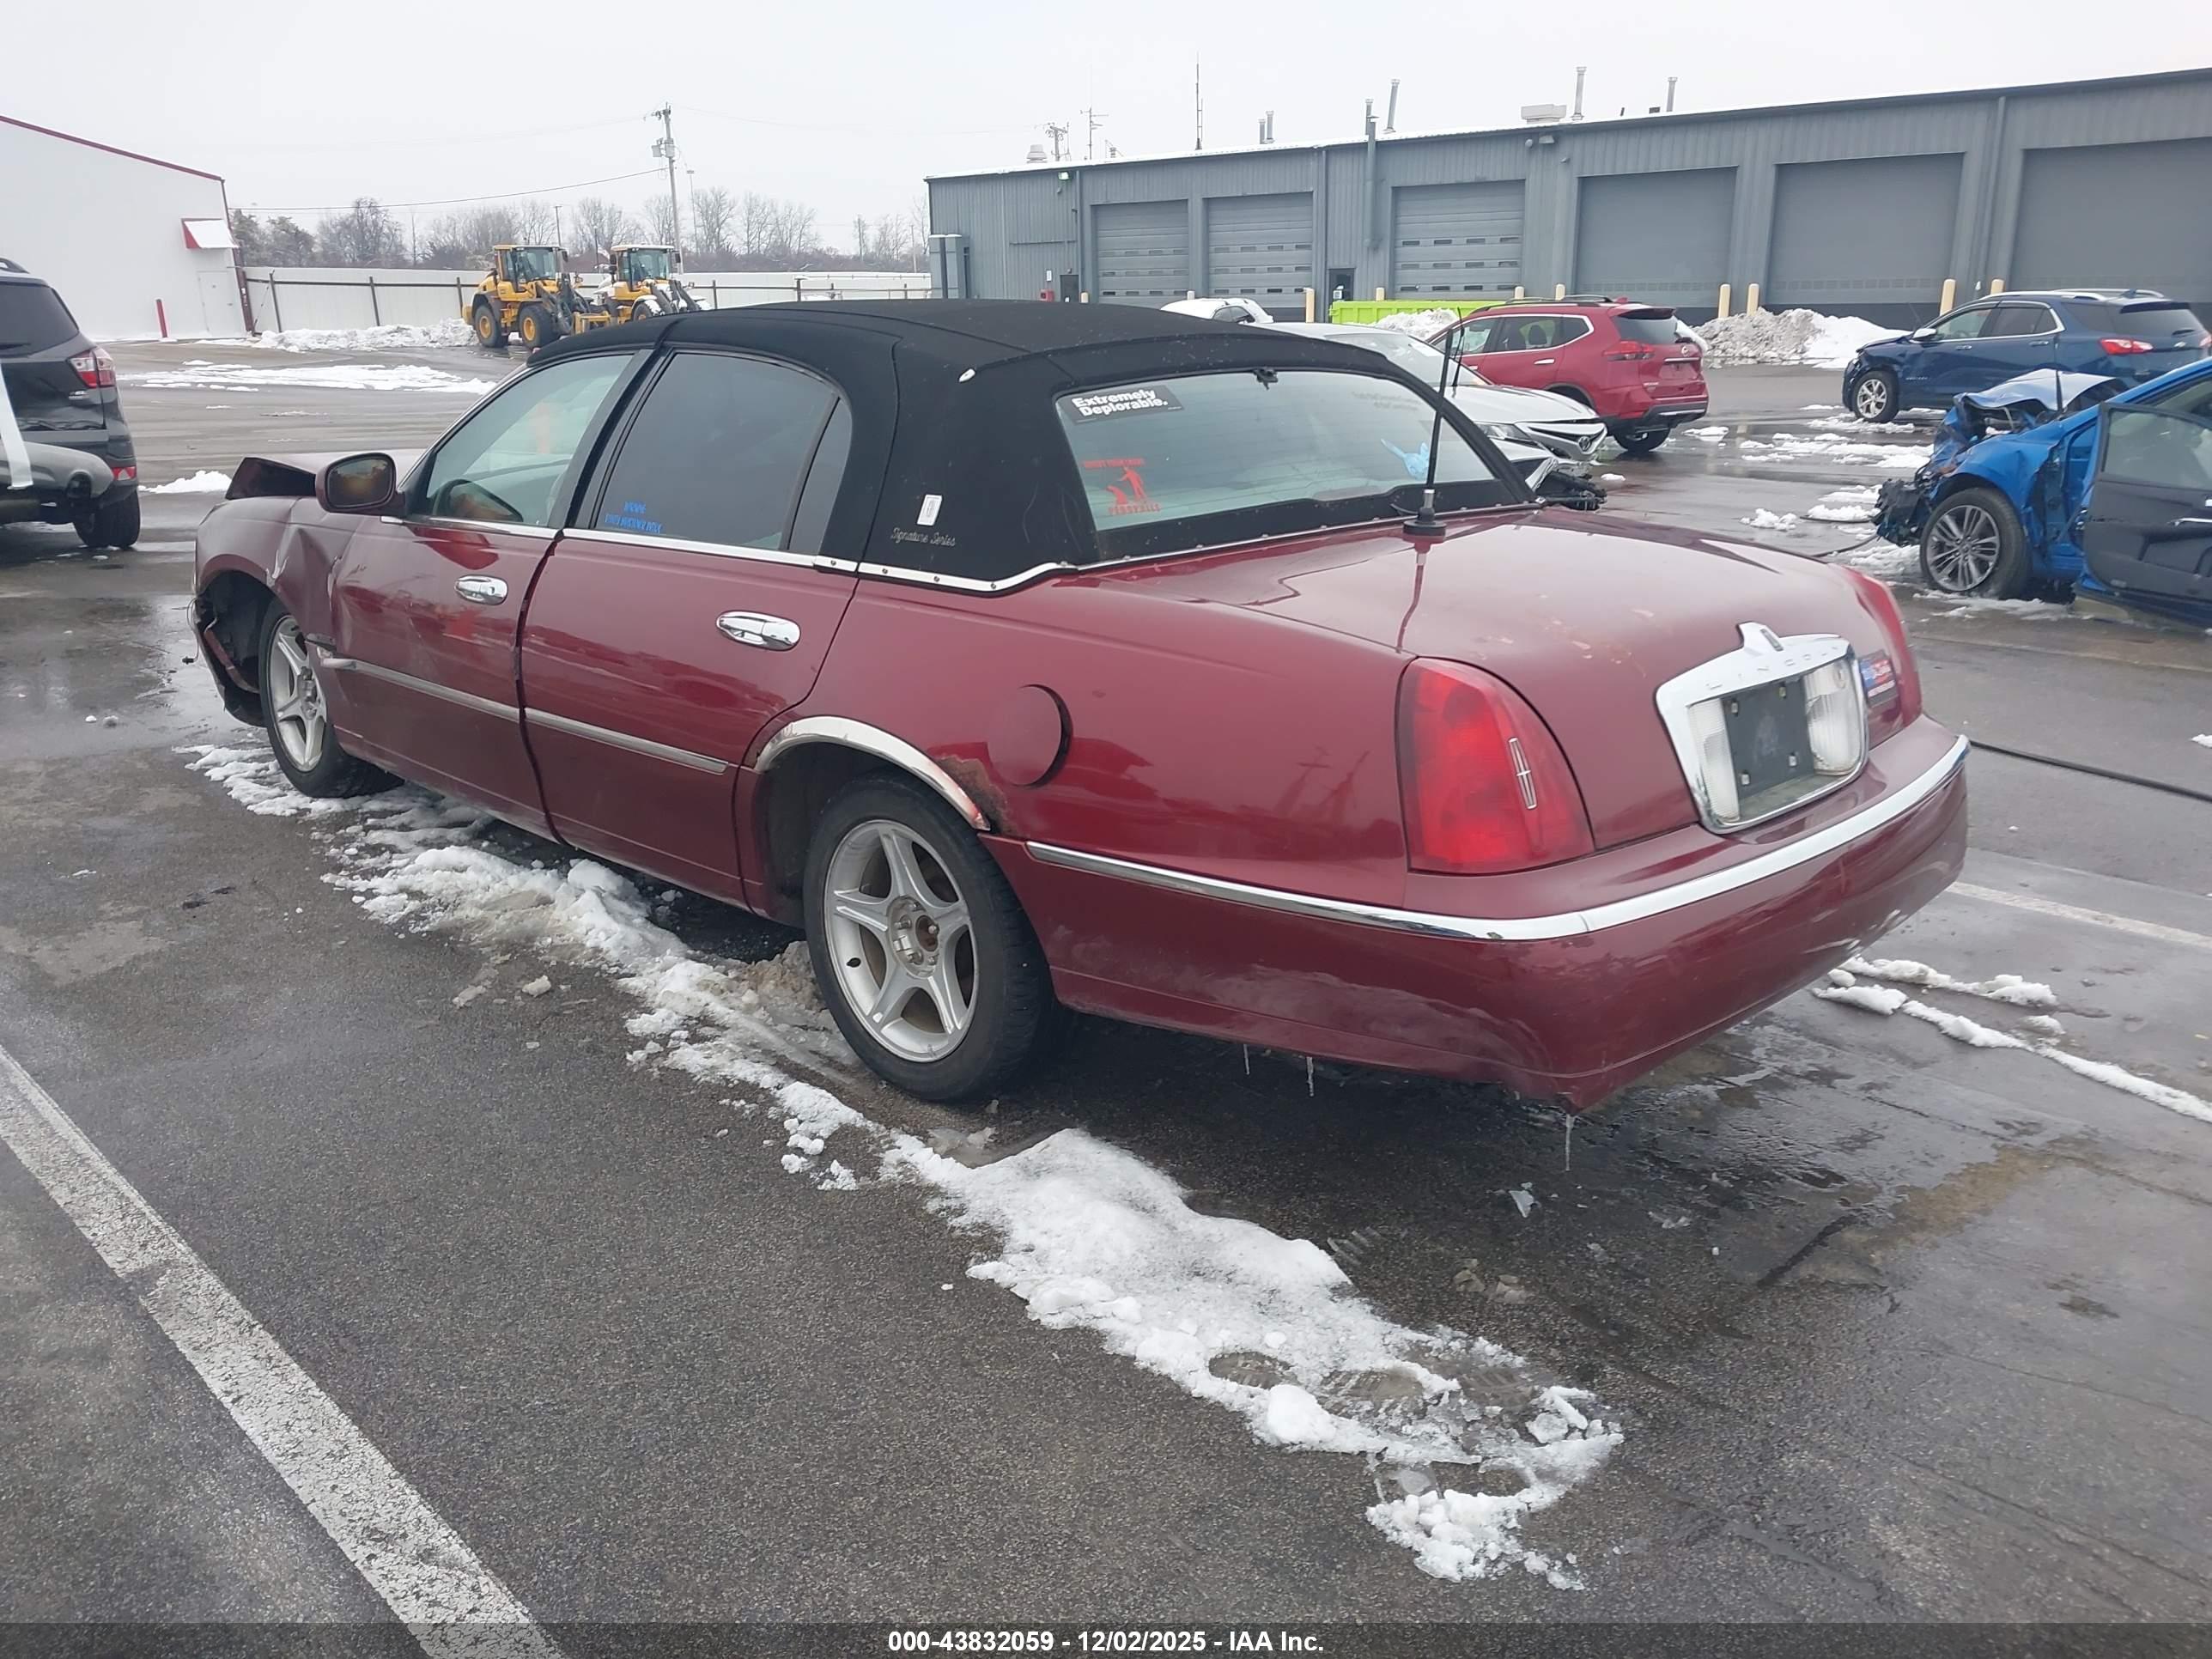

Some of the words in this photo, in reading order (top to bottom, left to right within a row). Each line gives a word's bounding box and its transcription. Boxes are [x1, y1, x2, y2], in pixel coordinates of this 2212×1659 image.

[1072, 389, 1156, 408] Extremely
[1079, 398, 1169, 416] Deplorable.
[930, 532, 957, 547] Series
